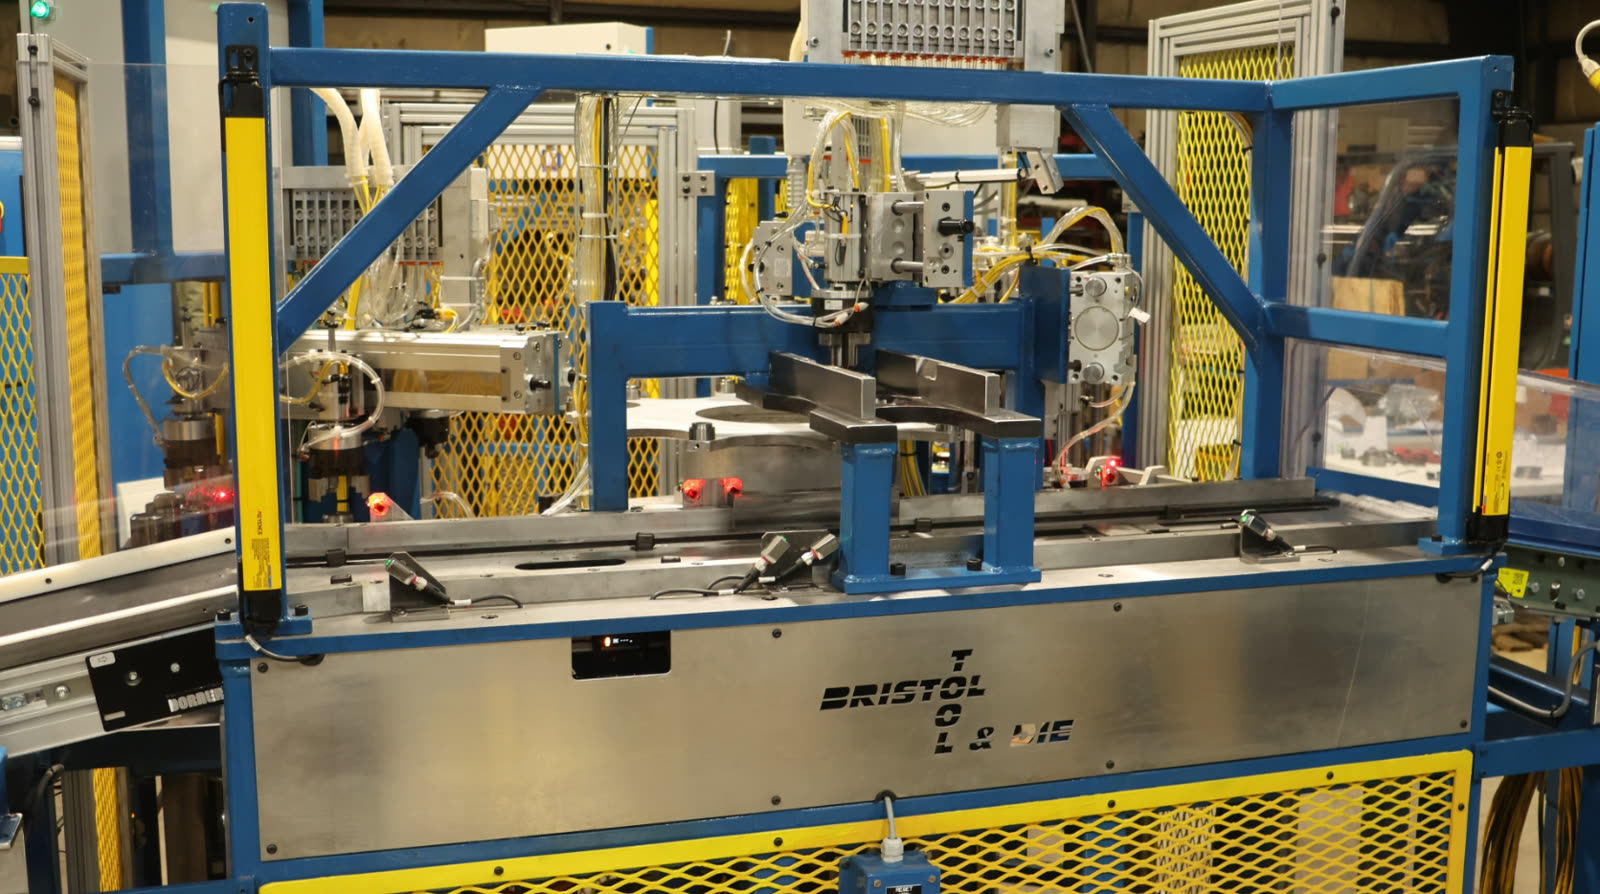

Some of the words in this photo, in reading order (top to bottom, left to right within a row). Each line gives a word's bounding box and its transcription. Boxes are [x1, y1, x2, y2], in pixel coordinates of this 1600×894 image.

[820, 675, 985, 710] BRISTOL
[969, 726, 994, 751] &
[1010, 719, 1074, 747] DIE
